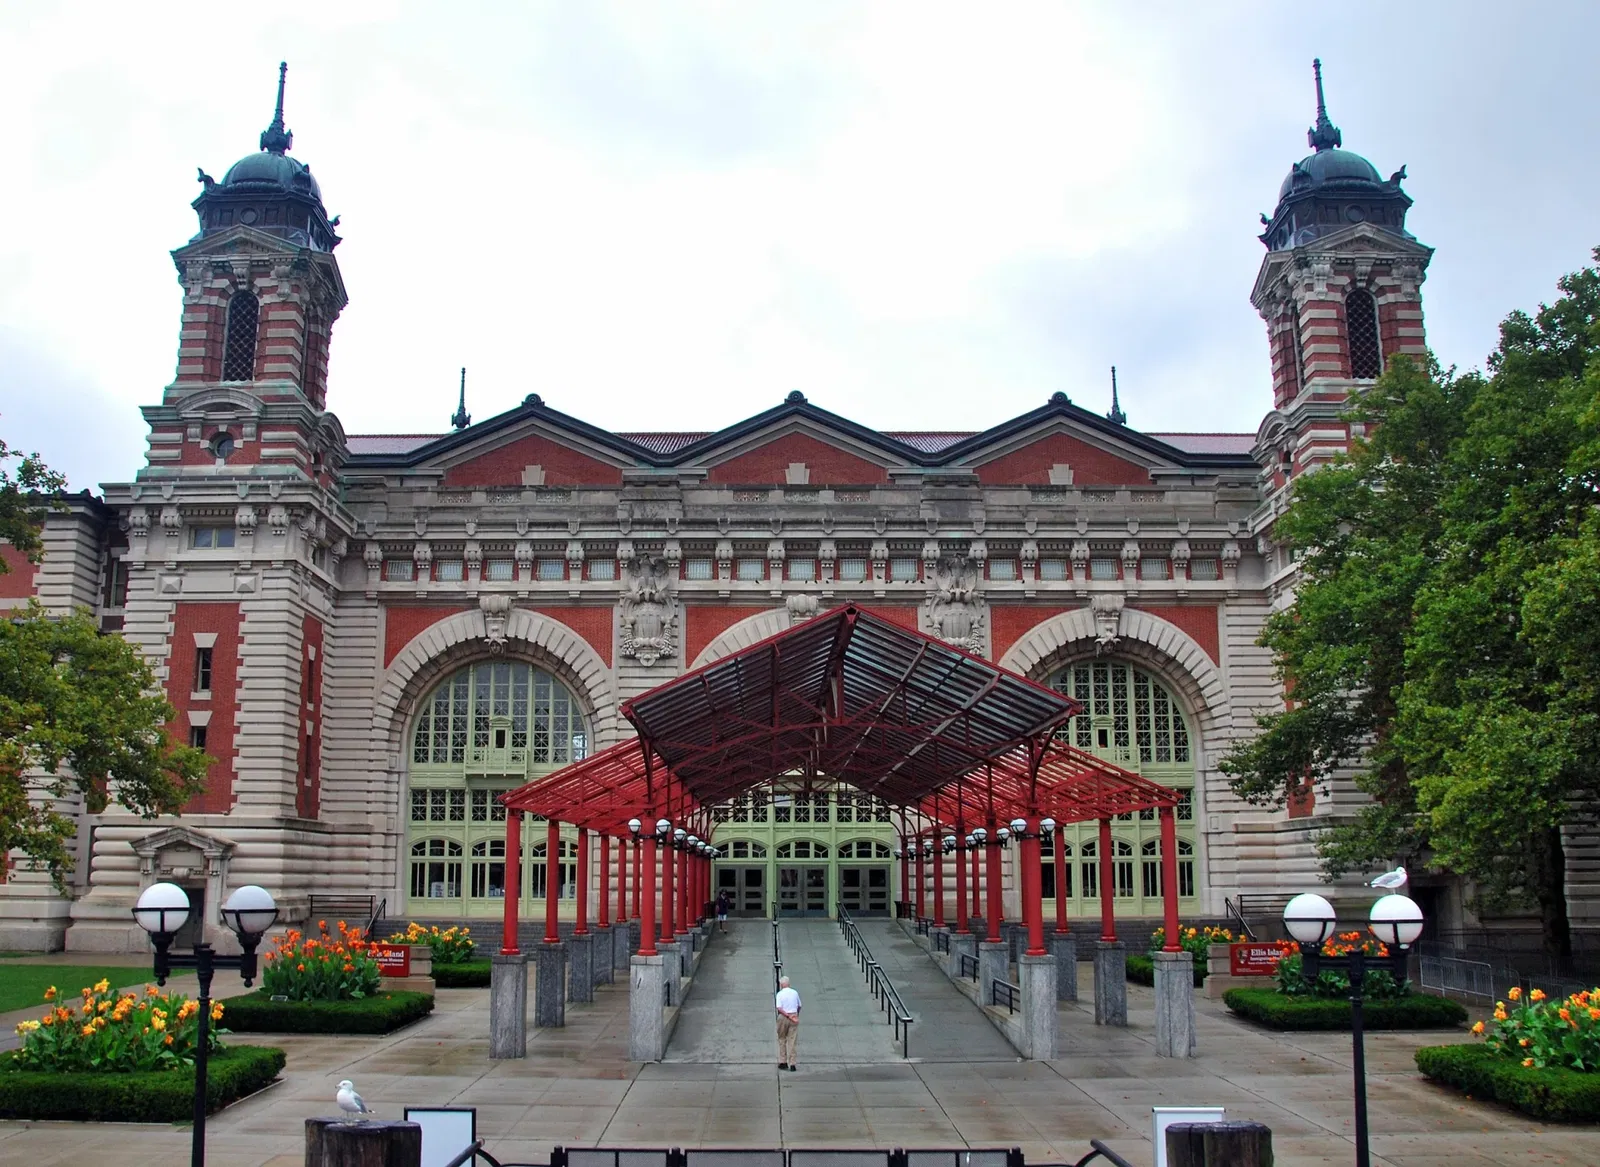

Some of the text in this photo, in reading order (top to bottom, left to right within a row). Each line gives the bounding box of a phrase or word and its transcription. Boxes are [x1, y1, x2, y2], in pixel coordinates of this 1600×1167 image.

[367, 949, 403, 957] Eis land
[1251, 948, 1284, 956] Ellis Islan
